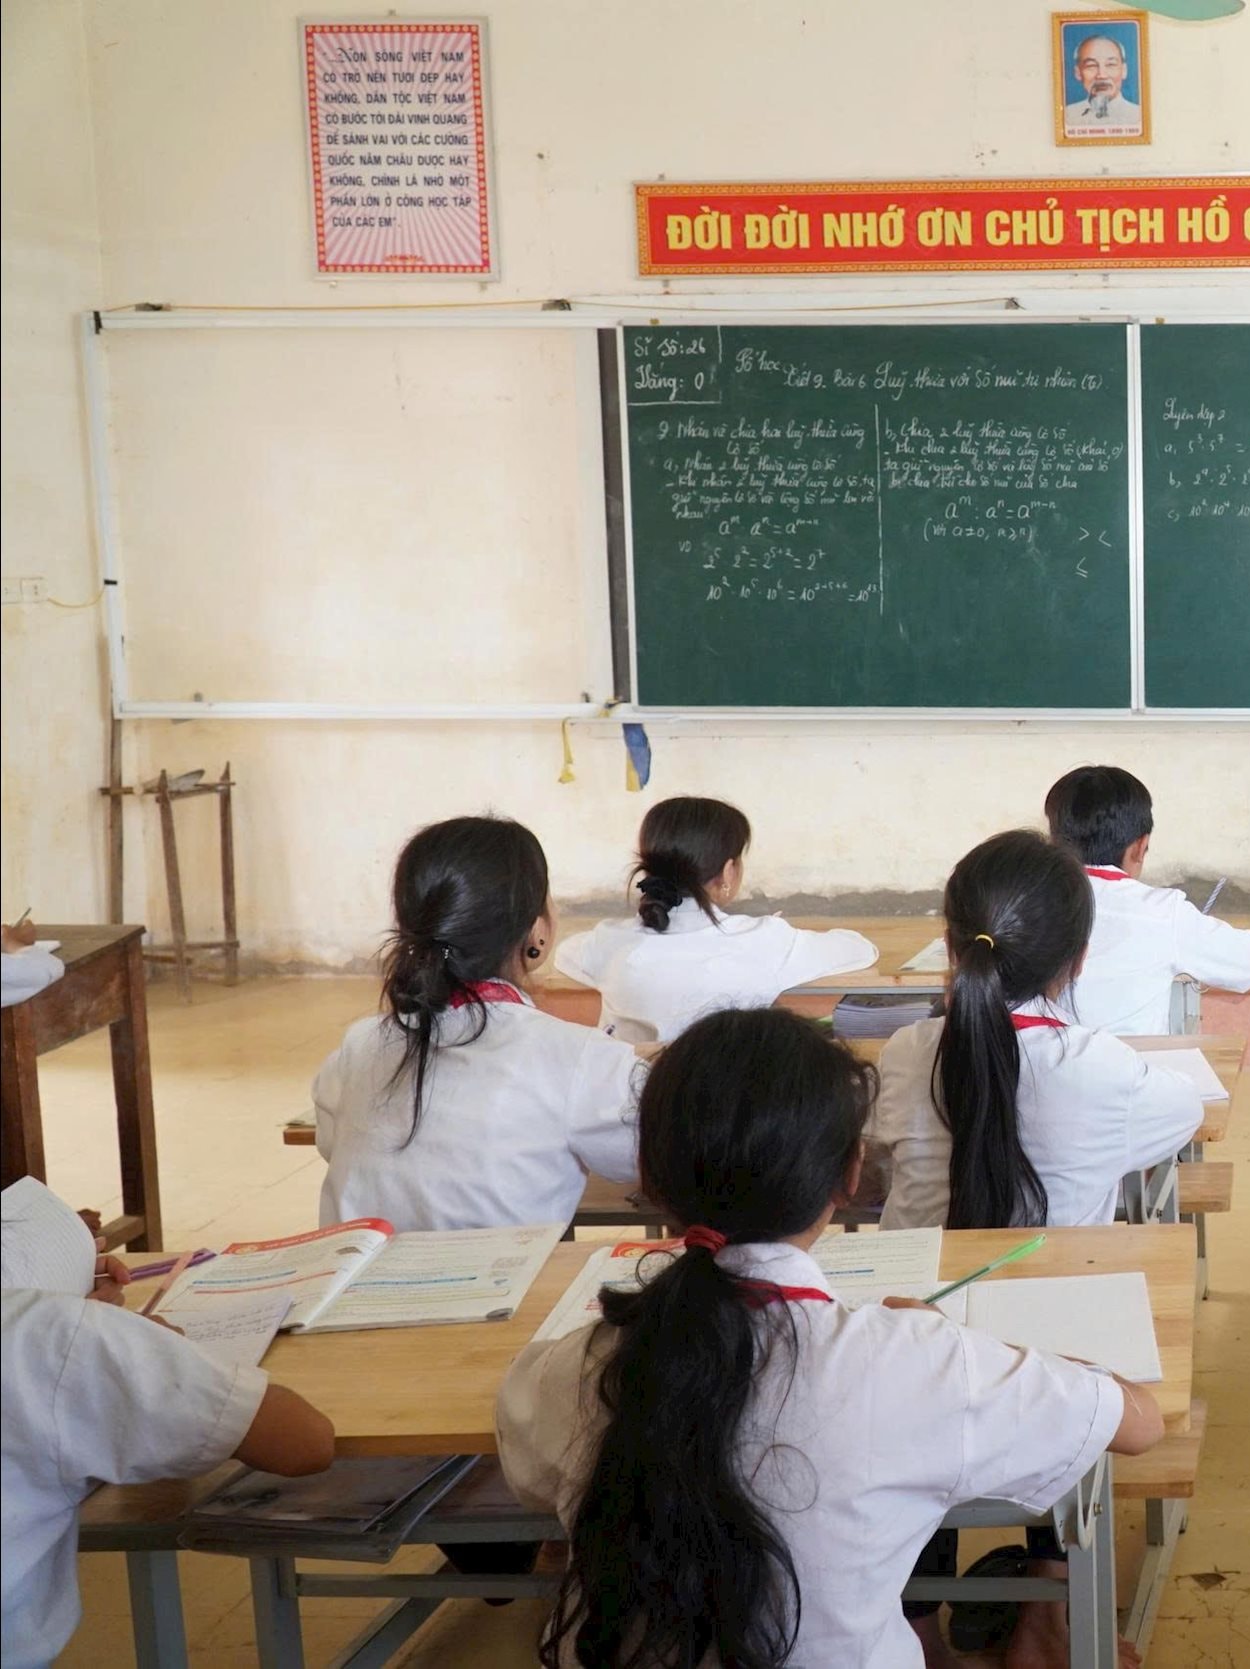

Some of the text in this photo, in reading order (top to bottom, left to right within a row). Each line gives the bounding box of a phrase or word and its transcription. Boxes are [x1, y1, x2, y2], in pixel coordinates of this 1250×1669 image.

[440, 51, 464, 63] NAM
[445, 72, 464, 83] HAY
[444, 93, 466, 104] NAM
[407, 114, 430, 125] VINH
[433, 114, 467, 125] QUANG
[372, 135, 388, 145] VAI
[450, 155, 469, 166] HAY
[666, 205, 732, 250] ĐỜI
[744, 204, 810, 249] ĐỜI
[823, 203, 905, 248] NHỚ
[917, 206, 973, 247] ƠN
[985, 197, 1065, 246] CHỦ
[1076, 207, 1164, 252] TỊCH
[1178, 194, 1230, 244] HỒ
